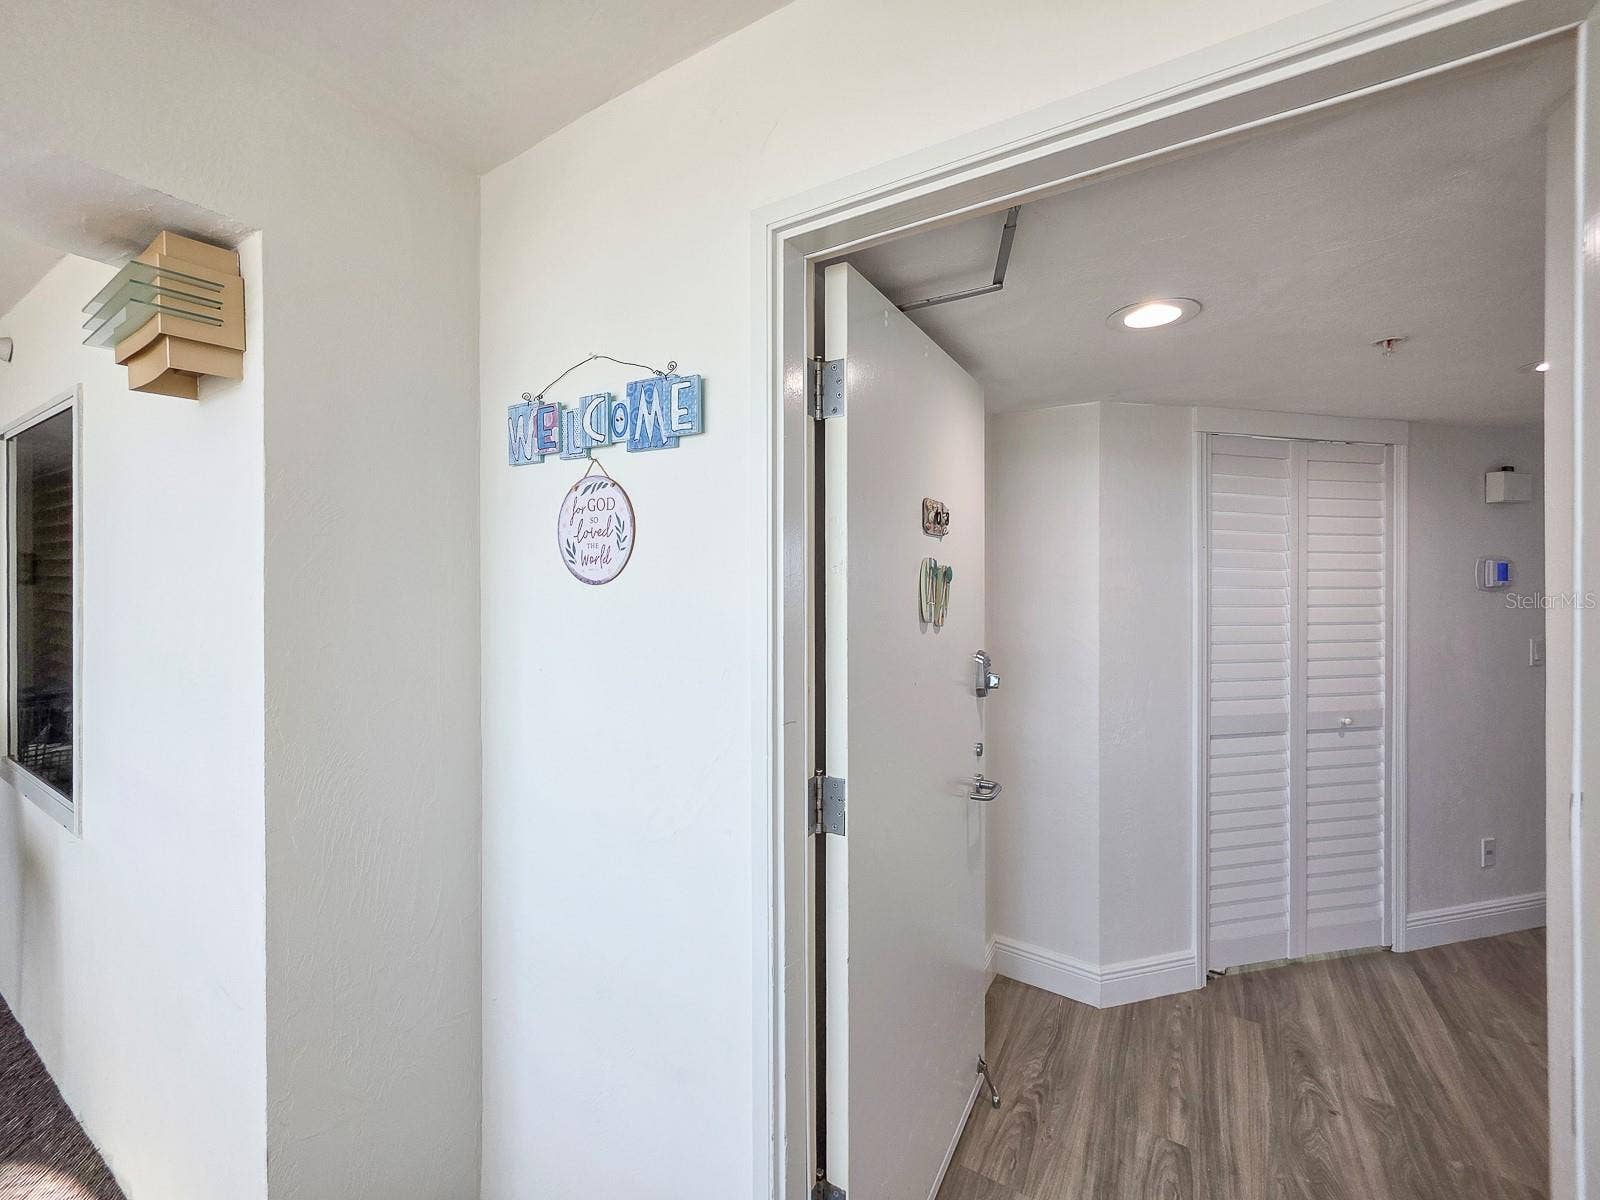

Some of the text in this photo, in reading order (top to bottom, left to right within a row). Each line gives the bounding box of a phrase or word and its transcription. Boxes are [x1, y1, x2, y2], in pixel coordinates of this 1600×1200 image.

[508, 379, 692, 461] WELCOME
[570, 496, 615, 526] for GOD
[573, 514, 613, 543] loved
[587, 542, 600, 550] THE
